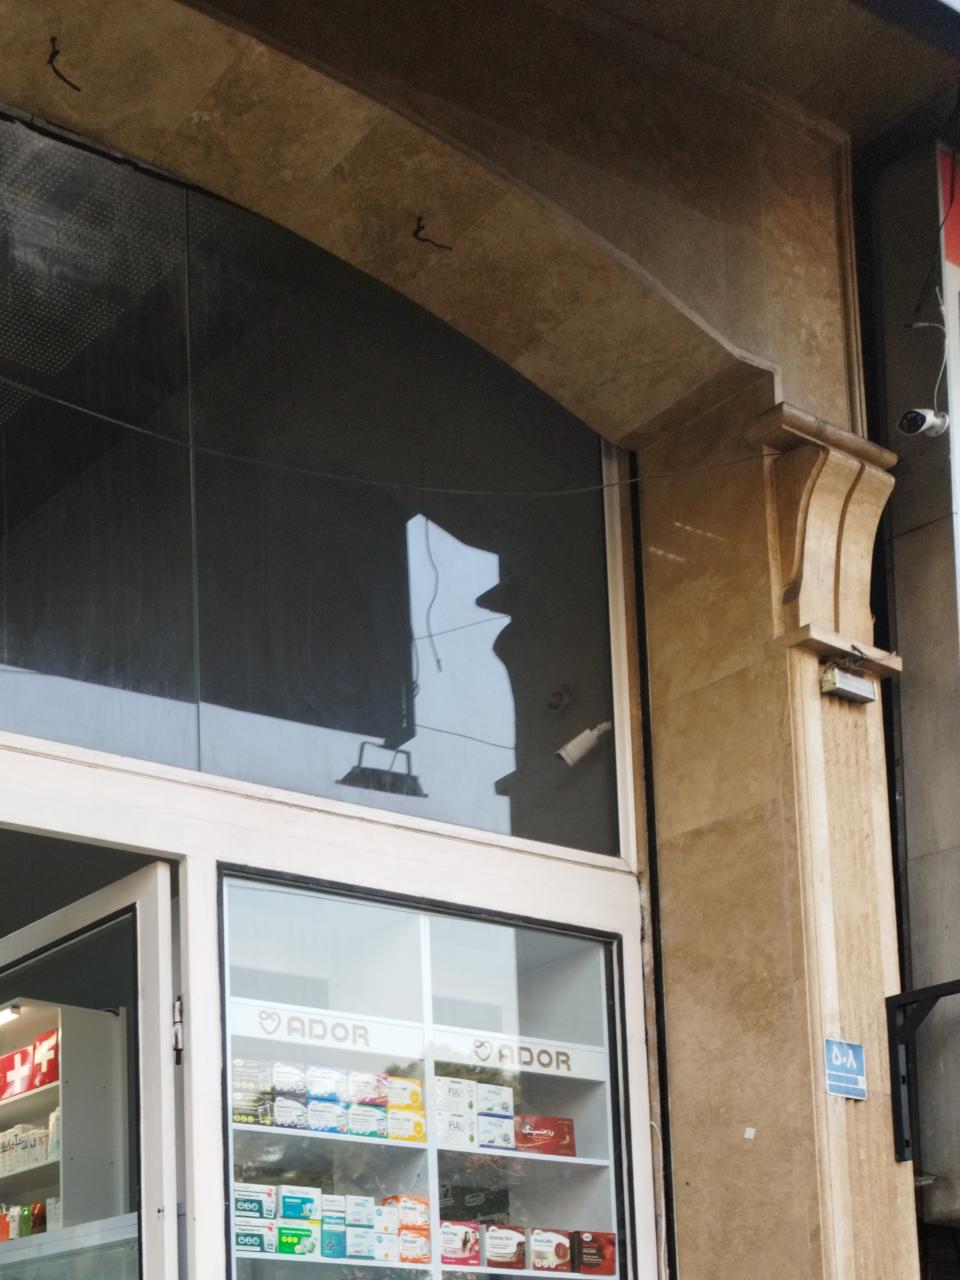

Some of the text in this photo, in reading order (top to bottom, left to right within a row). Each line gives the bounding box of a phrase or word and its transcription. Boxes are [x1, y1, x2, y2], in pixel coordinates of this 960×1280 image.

[287, 1016, 370, 1047] ADOR
[498, 1045, 572, 1071] ADOR
[831, 1045, 857, 1070] ۵۰۸
